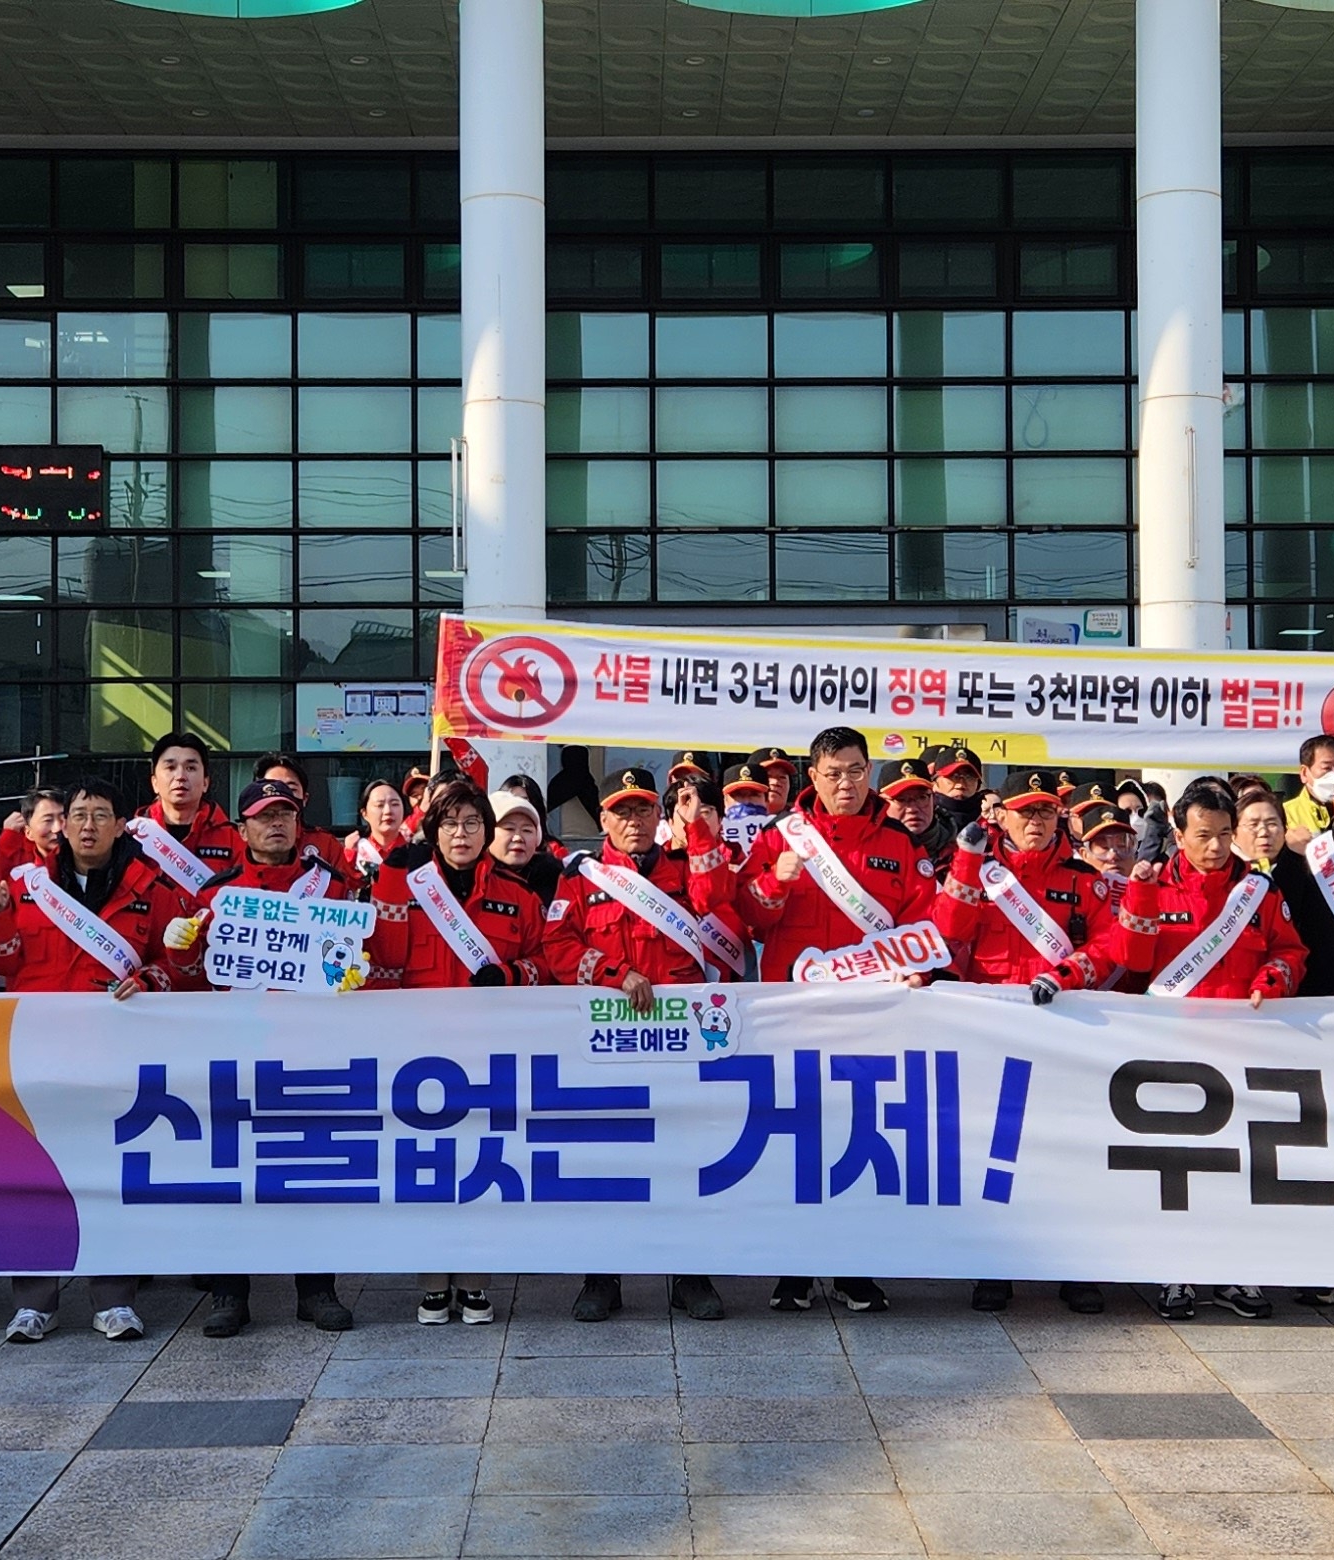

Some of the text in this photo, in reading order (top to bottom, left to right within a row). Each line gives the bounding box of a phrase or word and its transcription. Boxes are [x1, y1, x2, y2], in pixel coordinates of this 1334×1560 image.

[593, 653, 1303, 728] 산불 내면 3년 이하의 징역 또는 3천만원 이하 벌금!!
[219, 894, 369, 930] 산불없는 거제시
[215, 923, 310, 953] 우리 함께
[213, 954, 306, 985] 만들어요!
[589, 1028, 690, 1053] 산불예방
[113, 1053, 656, 1205] 산불없는
[699, 1050, 1034, 1207] 거제!
